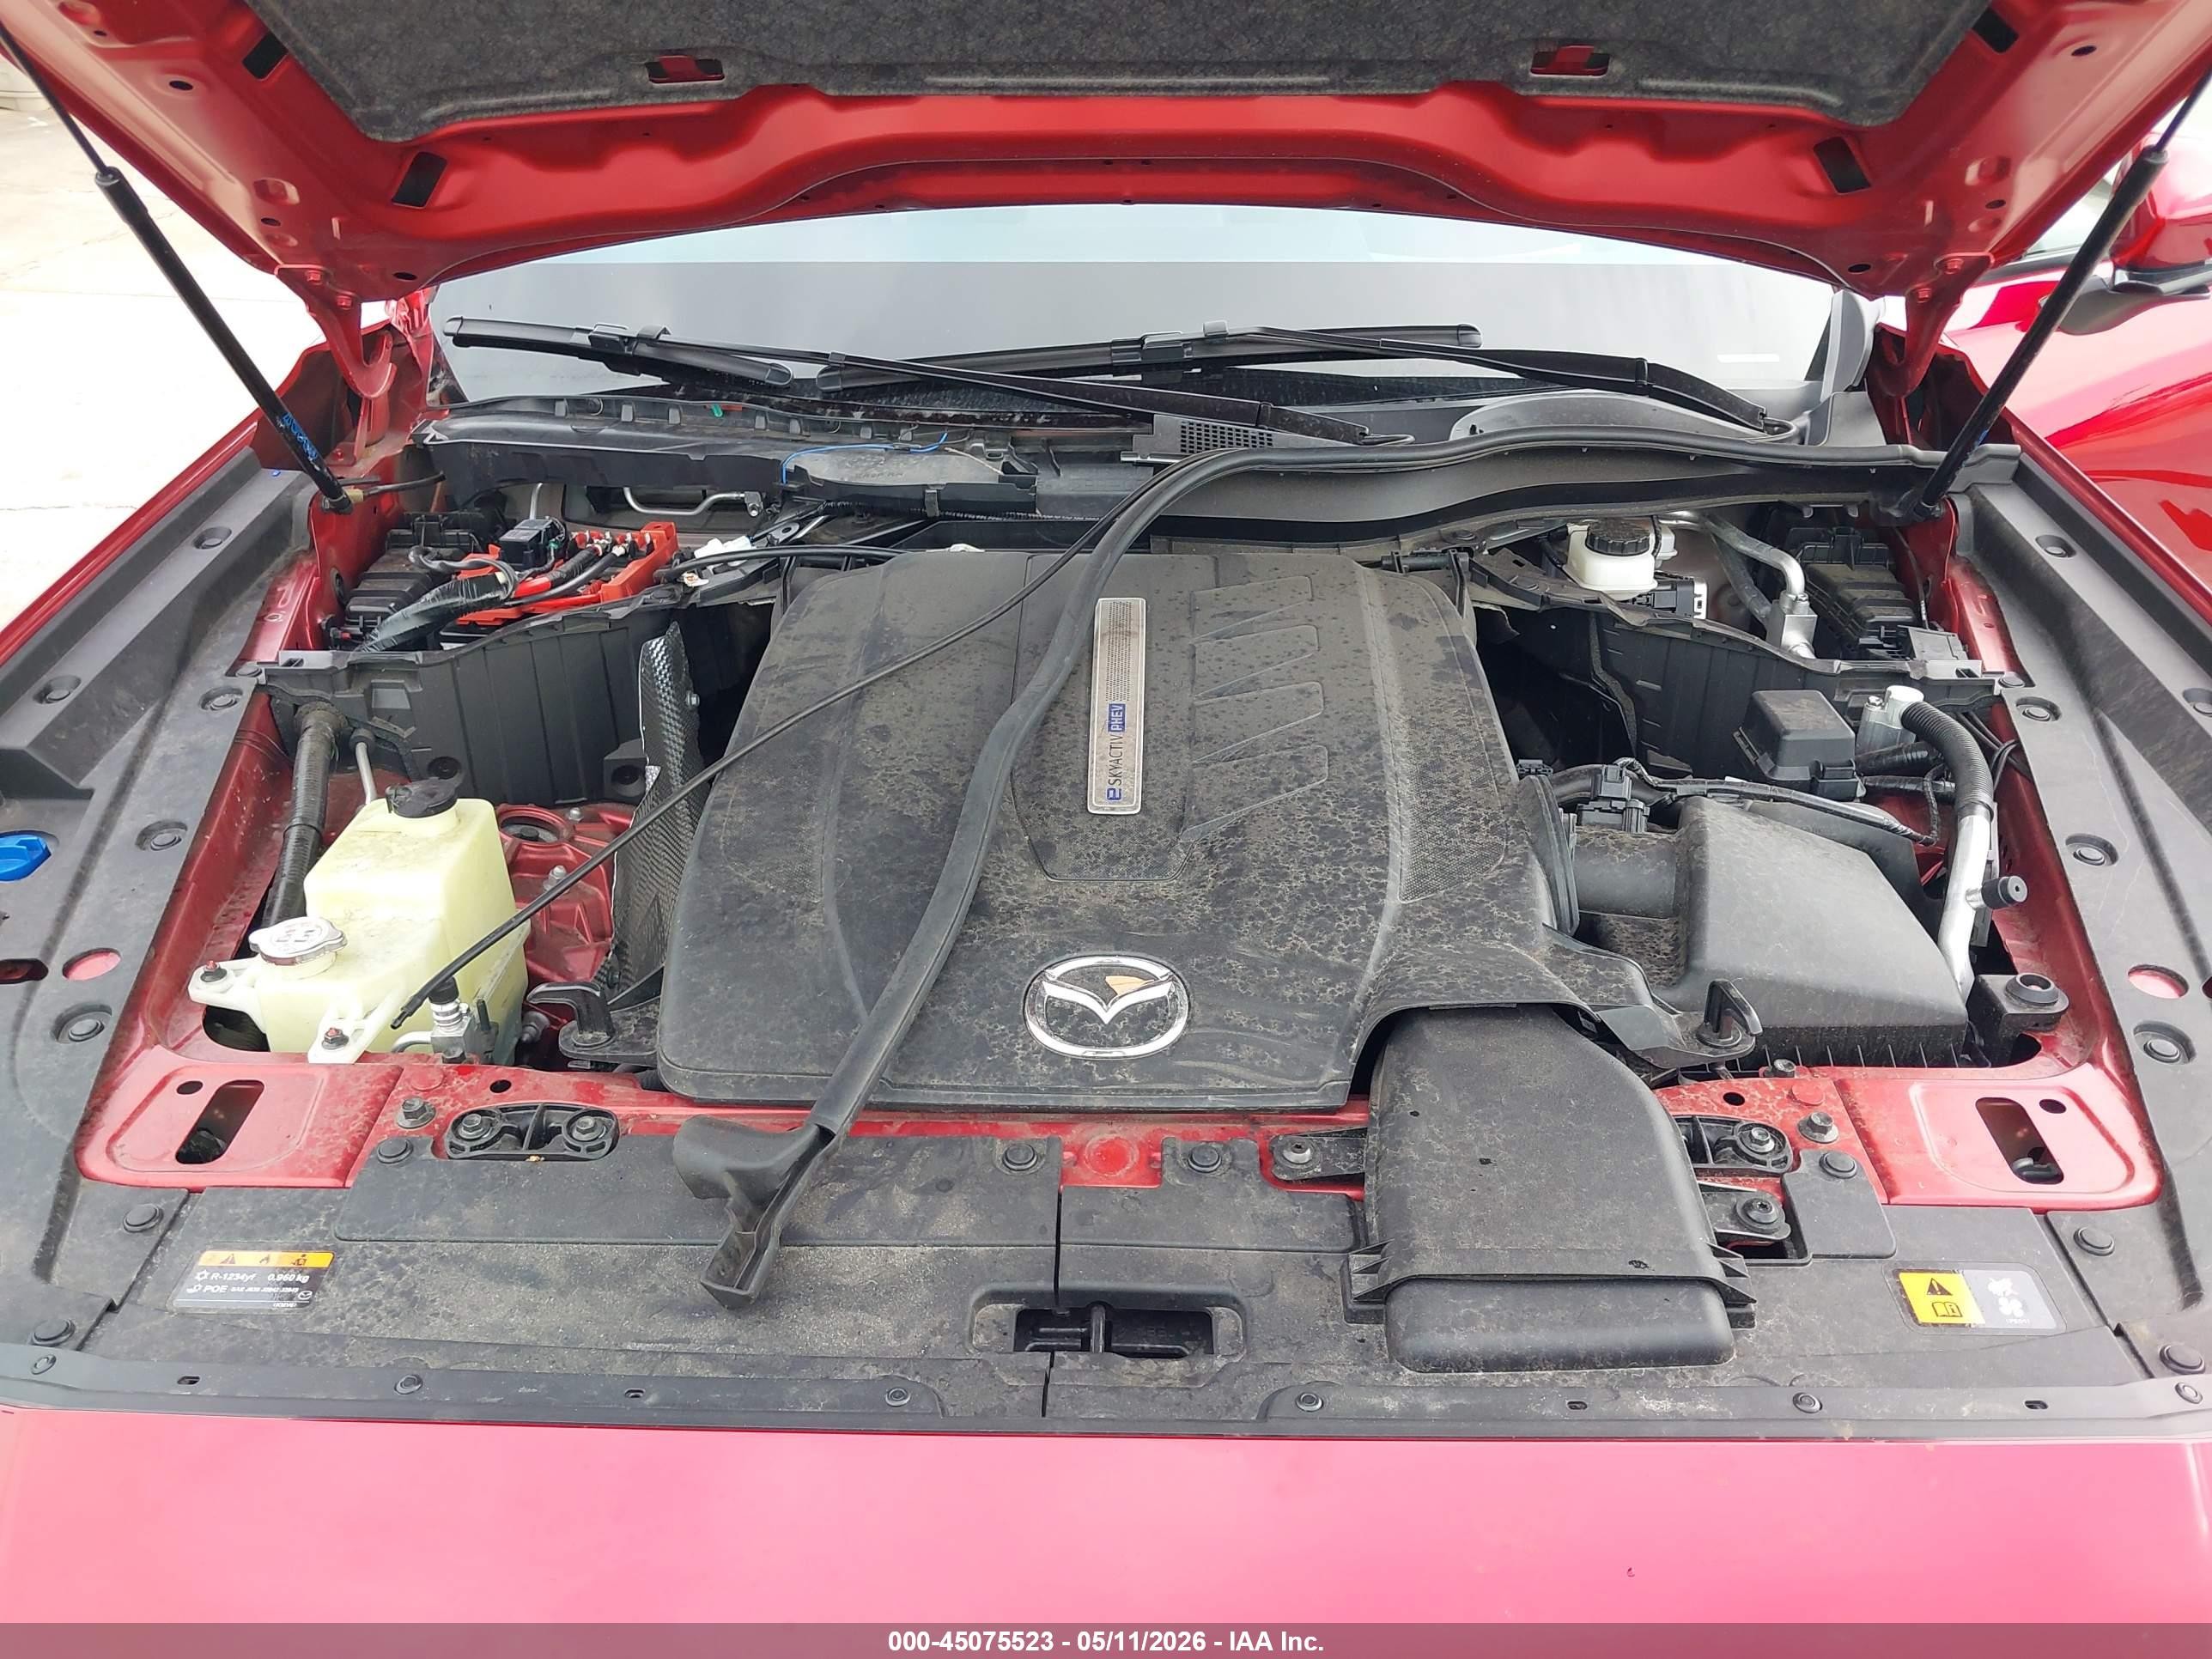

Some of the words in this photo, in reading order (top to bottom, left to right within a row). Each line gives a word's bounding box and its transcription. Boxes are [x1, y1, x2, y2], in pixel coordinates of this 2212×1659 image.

[1110, 704, 1124, 731] PHEV
[1108, 734, 1123, 786] SKYACTIV
[296, 1274, 310, 1284] kg
[203, 1285, 228, 1293] POE
